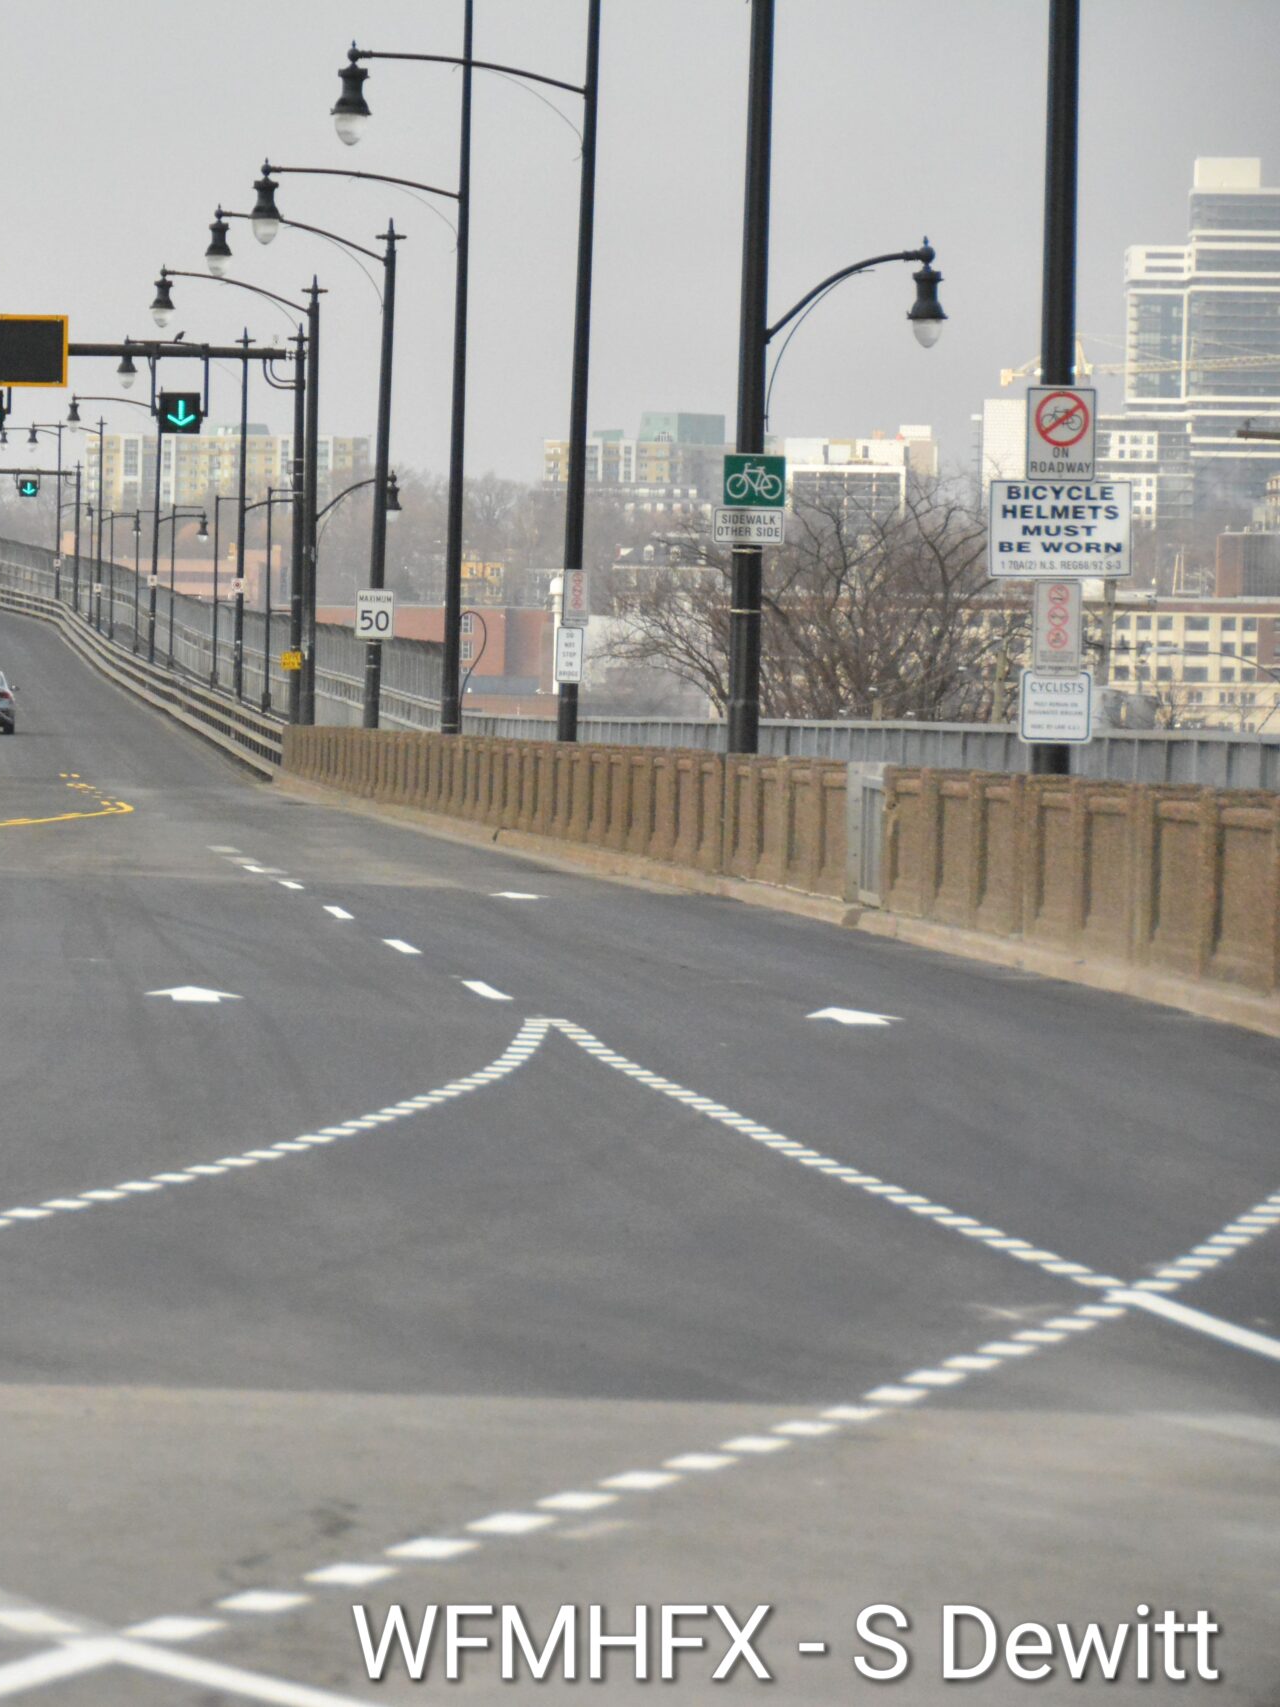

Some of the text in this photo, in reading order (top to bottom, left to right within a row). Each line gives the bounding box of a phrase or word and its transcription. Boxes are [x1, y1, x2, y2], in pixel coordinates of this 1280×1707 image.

[1052, 447, 1069, 459] ON
[1030, 461, 1093, 474] ROADWAY
[1007, 485, 1115, 500] BICYCLE
[1001, 504, 1120, 520] HELMETS
[721, 514, 776, 525] SIDEWALK
[716, 526, 780, 538] OTHER SIDE
[1021, 525, 1097, 537] MUST
[998, 541, 1123, 554] BE WORN
[360, 609, 390, 632] 50
[1030, 681, 1085, 693] CYCLISTS
